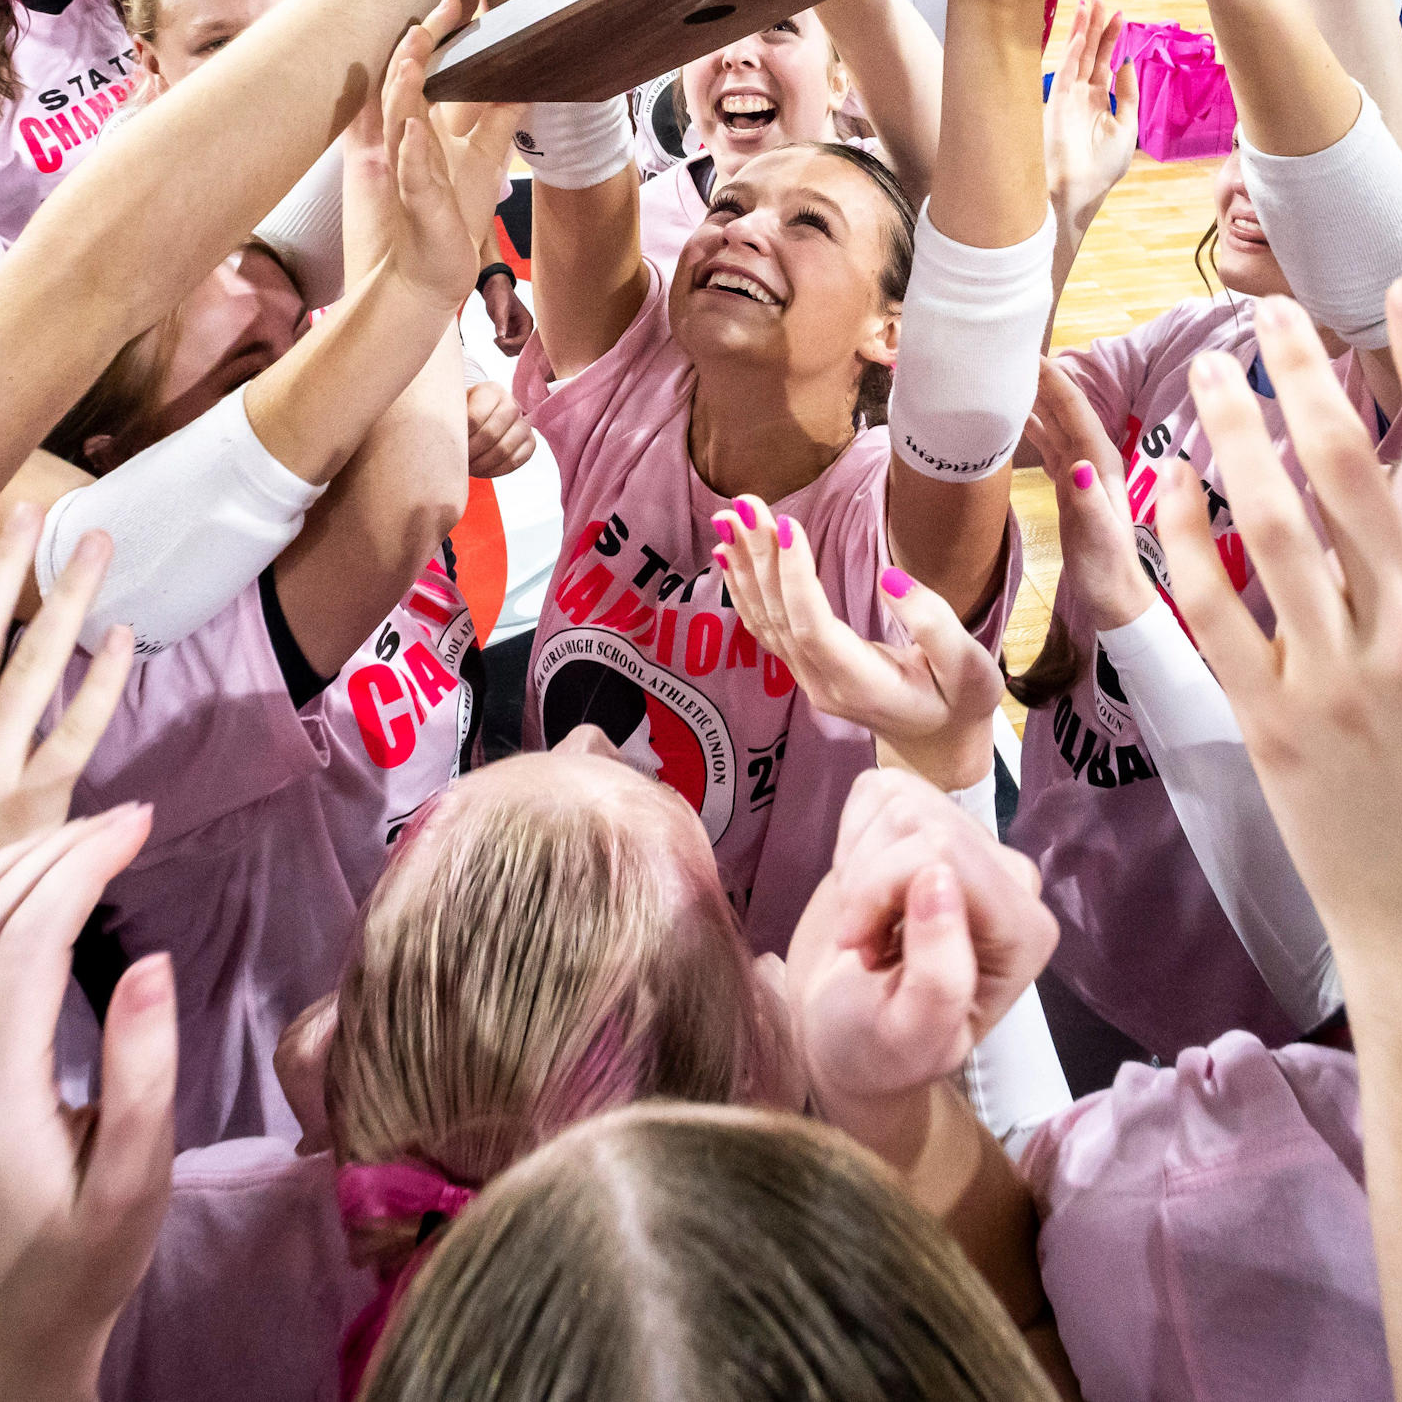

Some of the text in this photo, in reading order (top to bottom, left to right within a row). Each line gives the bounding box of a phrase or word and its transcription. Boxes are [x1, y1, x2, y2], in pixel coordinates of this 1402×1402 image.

[565, 638, 594, 655] HIGH
[596, 641, 647, 682] SCHOOL
[648, 676, 713, 730] ATHLETIC
[705, 727, 727, 786] UNION
